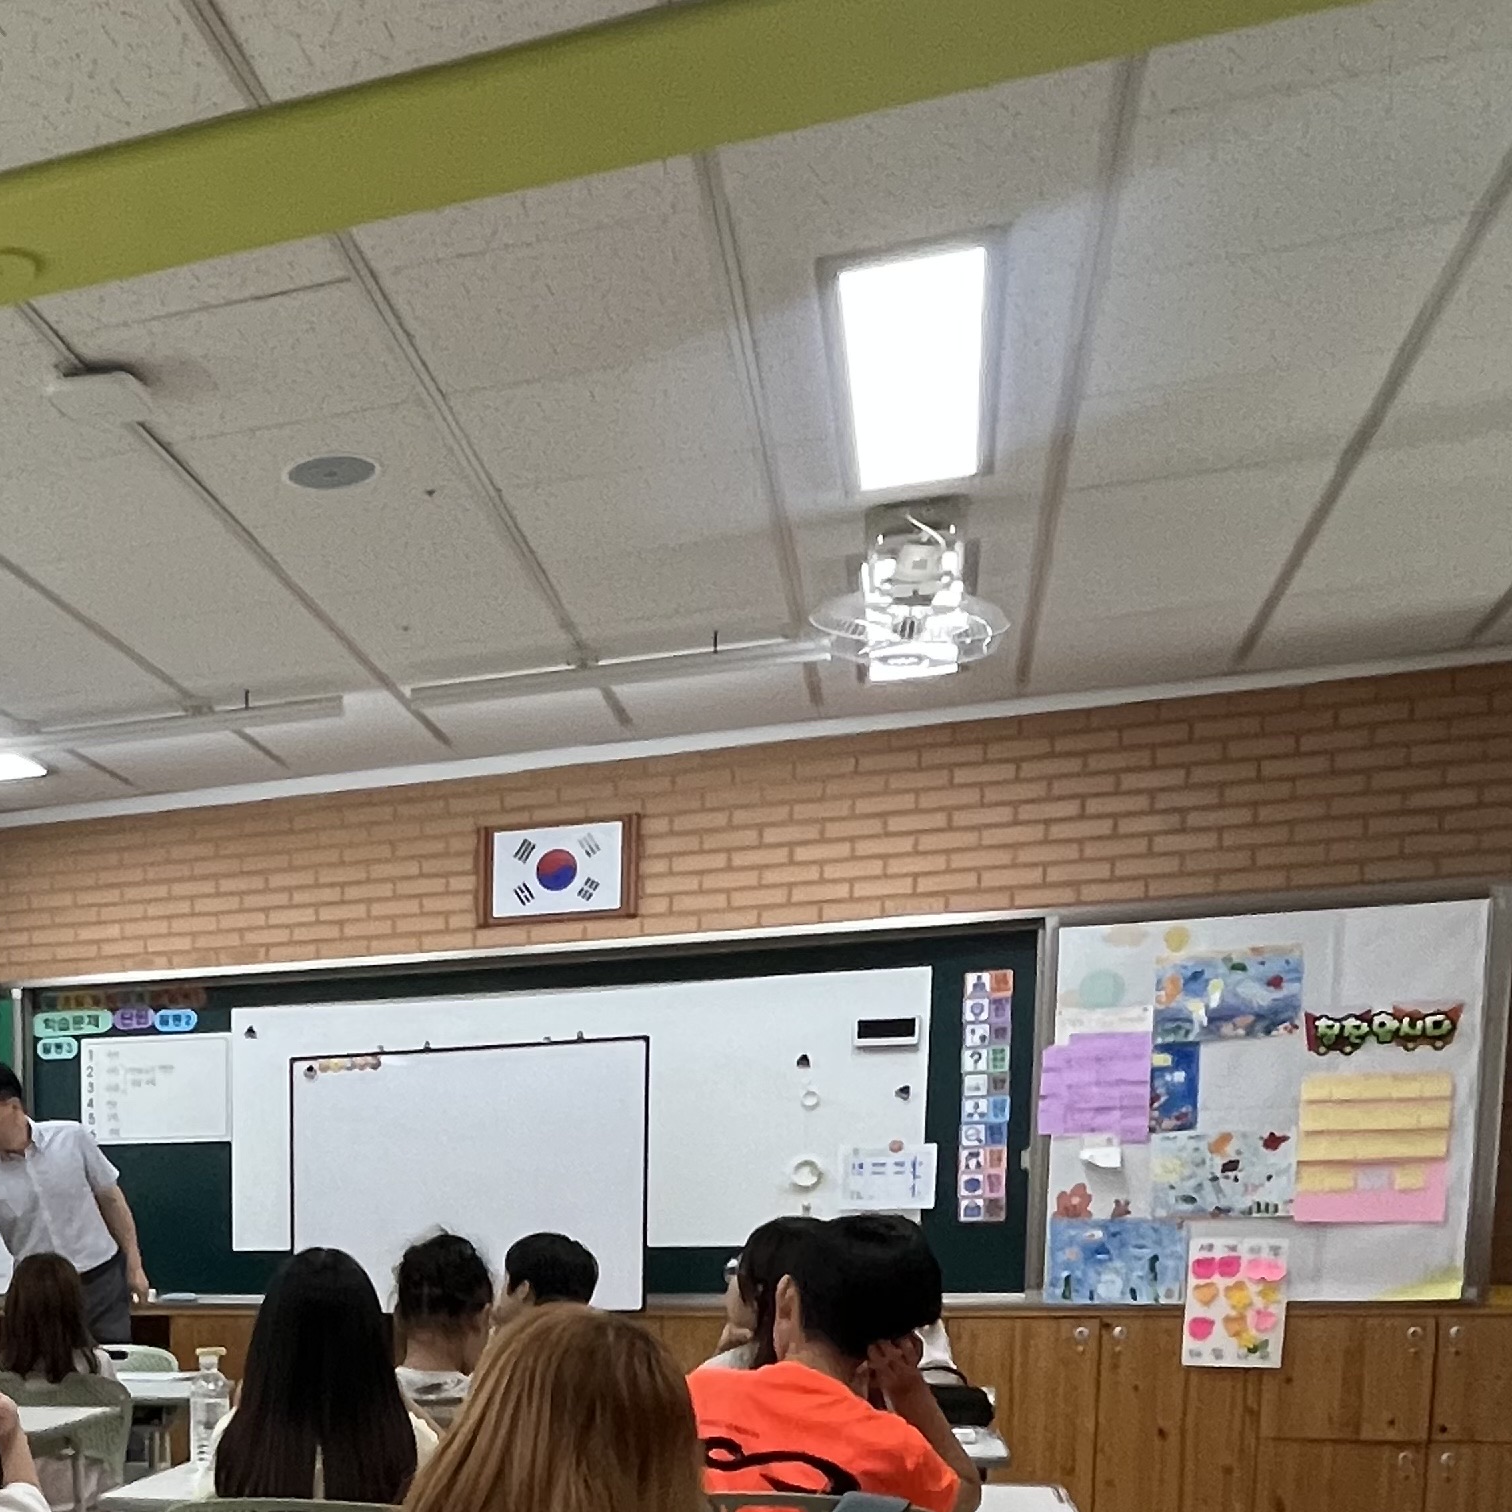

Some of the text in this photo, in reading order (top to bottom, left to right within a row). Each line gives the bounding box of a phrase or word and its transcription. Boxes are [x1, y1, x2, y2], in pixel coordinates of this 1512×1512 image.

[87, 1066, 94, 1078] 2
[87, 1082, 94, 1093] 3
[87, 1098, 94, 1109] 4
